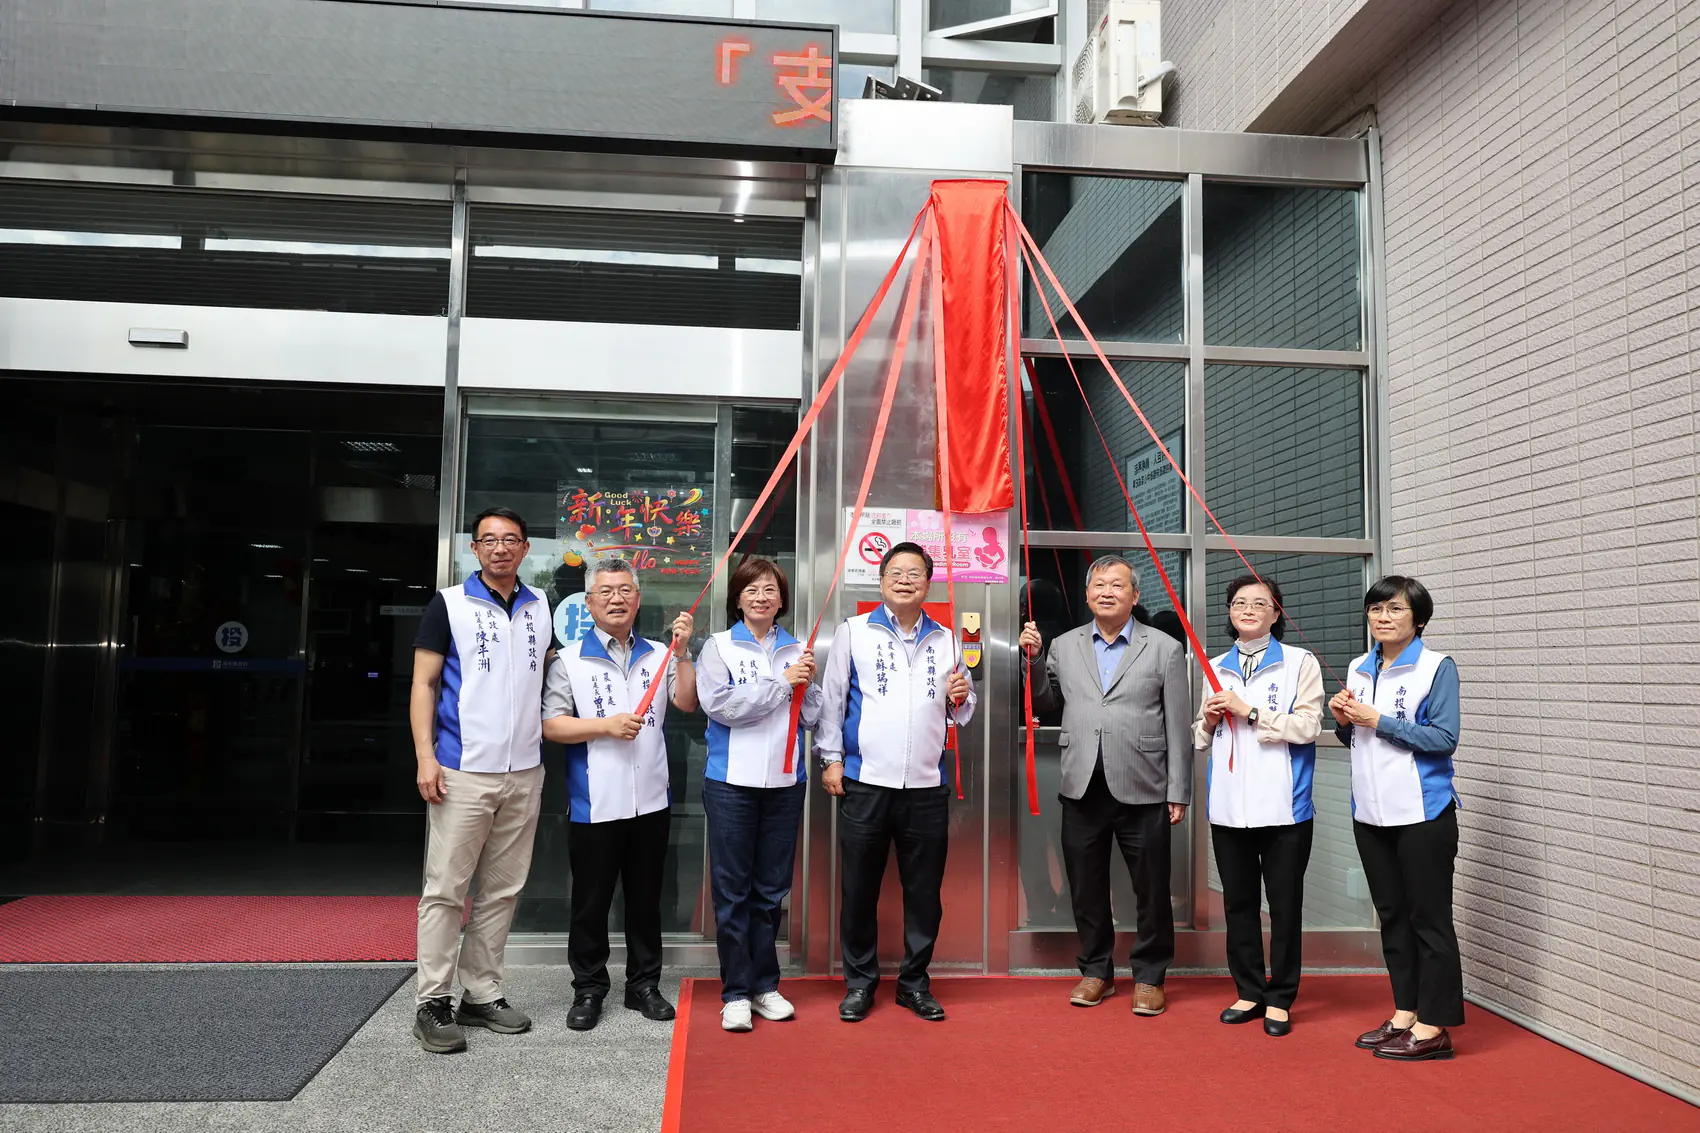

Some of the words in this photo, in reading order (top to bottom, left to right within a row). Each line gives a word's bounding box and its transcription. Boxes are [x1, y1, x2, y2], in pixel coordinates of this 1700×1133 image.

[567, 488, 702, 542] 新年快樂
[604, 491, 628, 499] Good
[487, 609, 500, 643] 民政處
[524, 610, 538, 672] 南投縣政府
[925, 645, 937, 699] 南投縣政府
